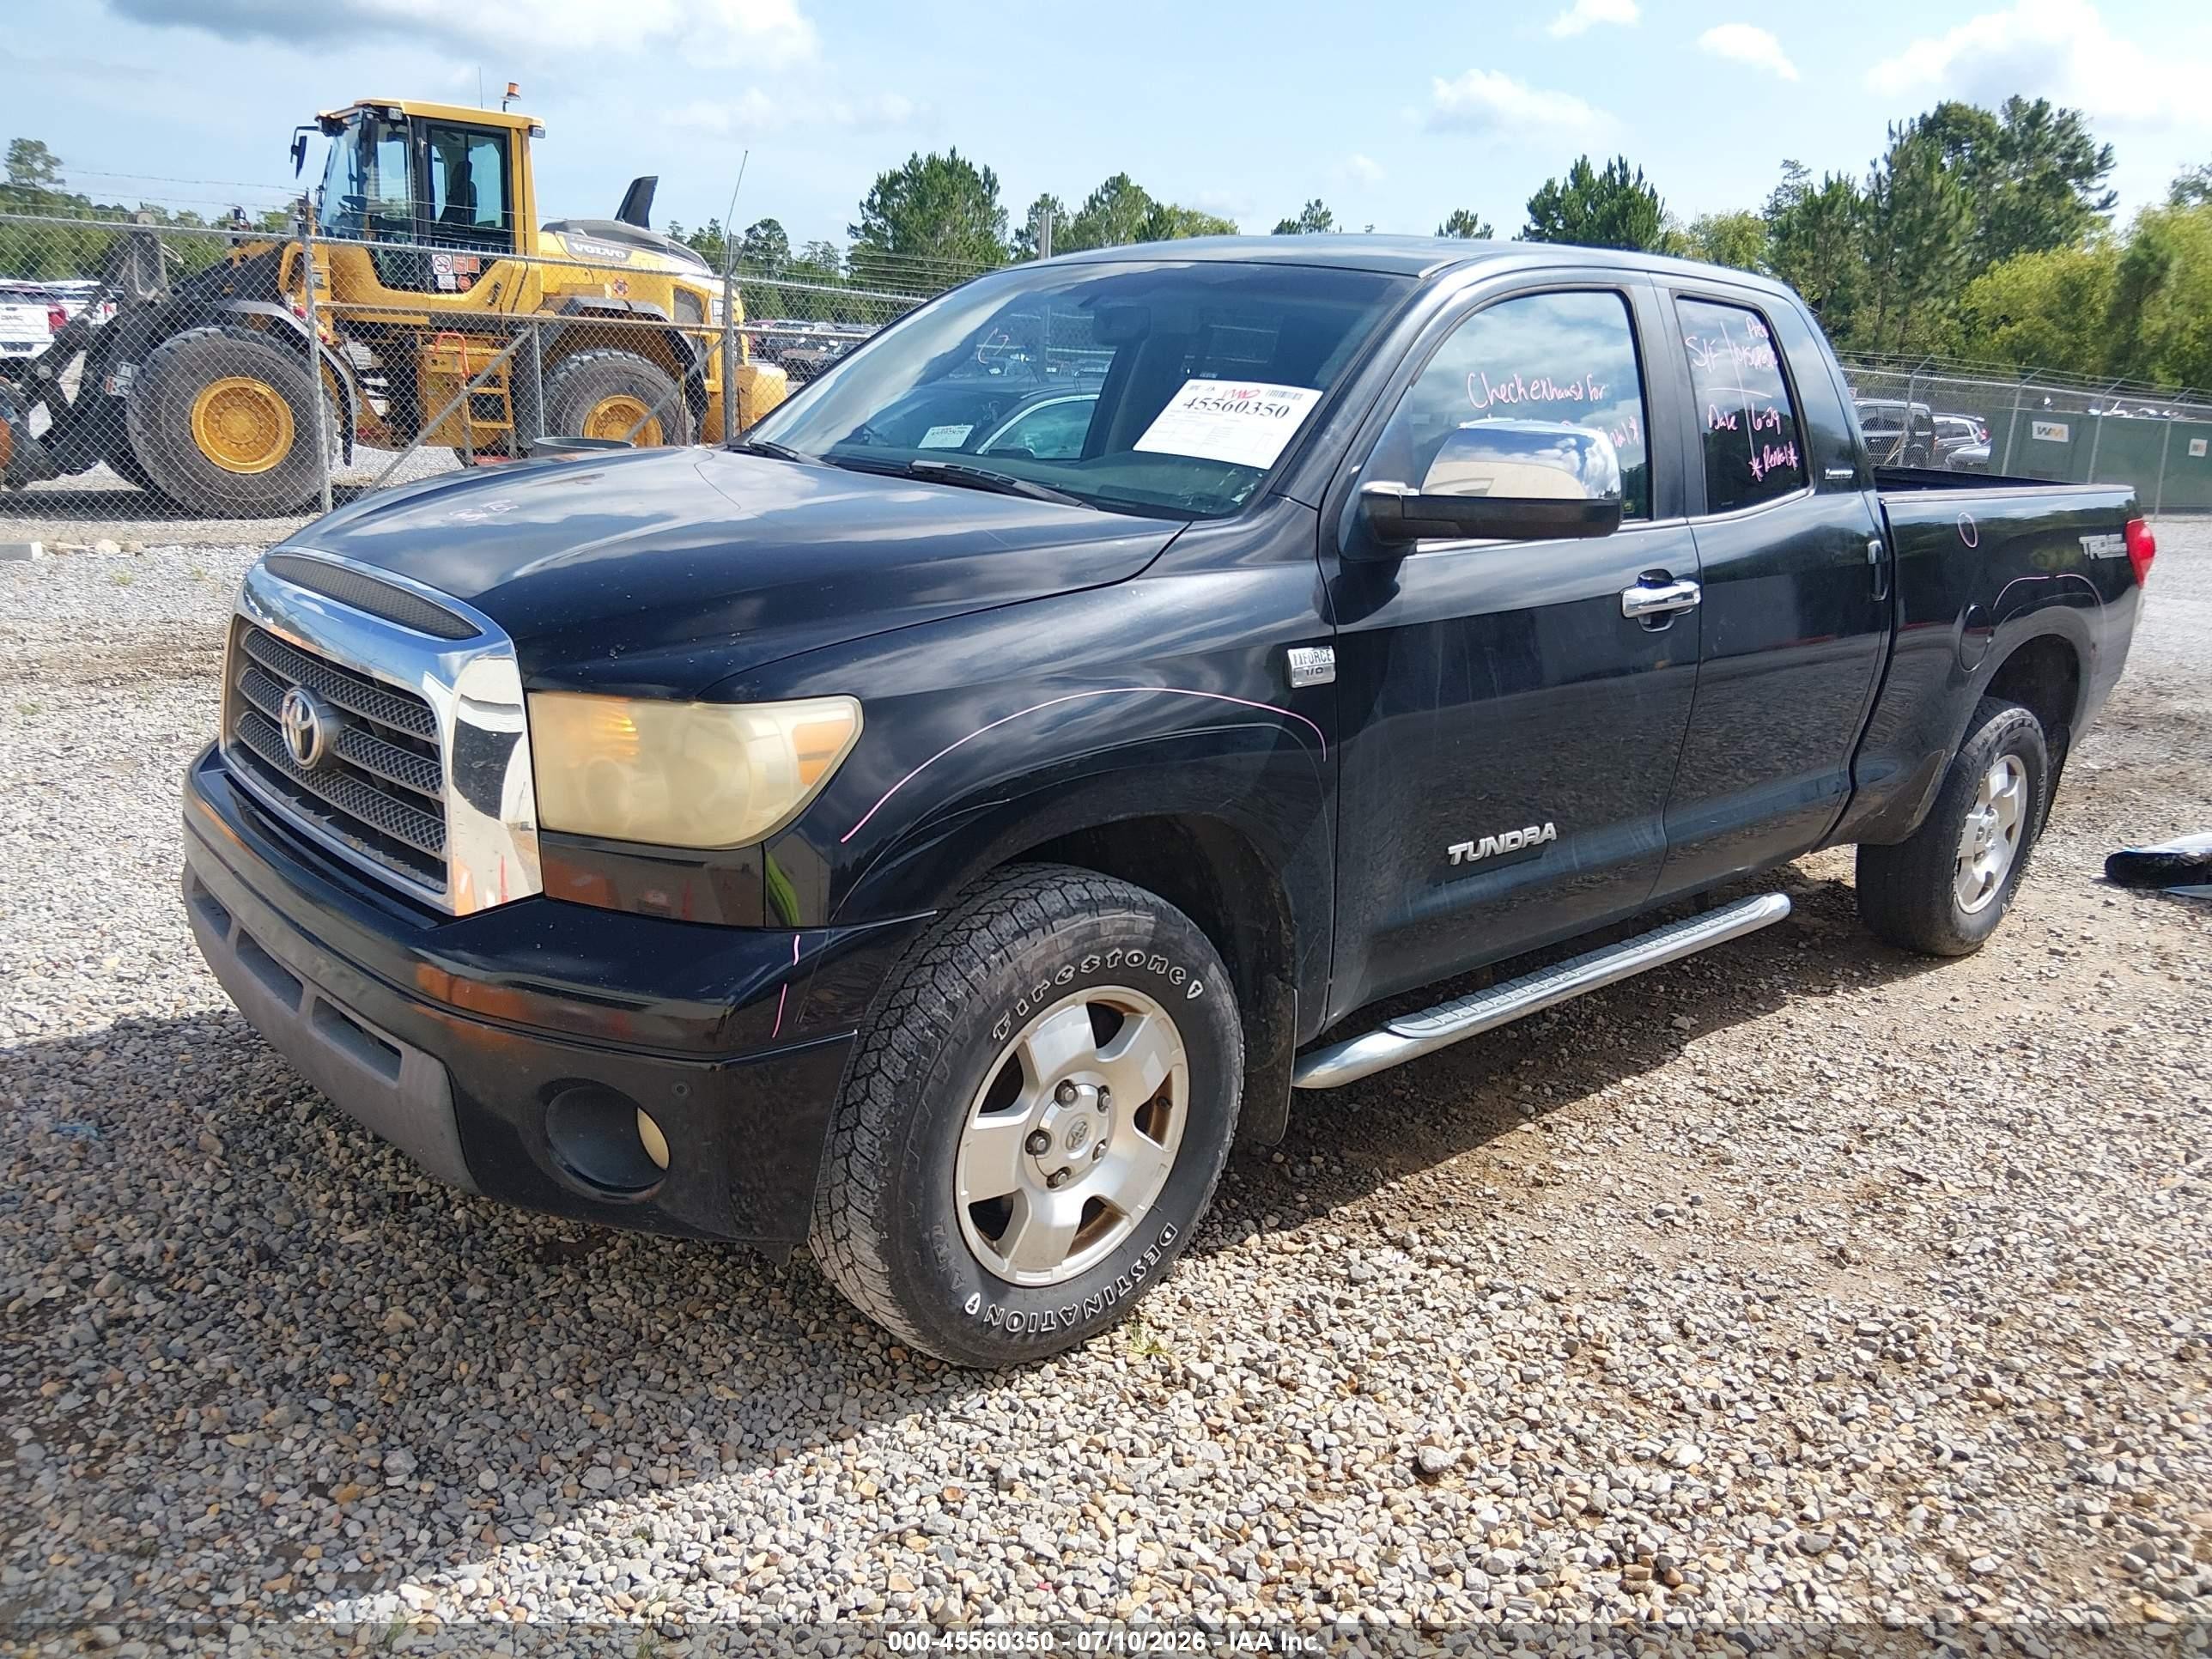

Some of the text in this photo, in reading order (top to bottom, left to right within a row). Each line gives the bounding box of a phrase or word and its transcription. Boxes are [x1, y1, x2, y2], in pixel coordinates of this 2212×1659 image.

[569, 241, 627, 258] VOLVO
[1182, 396, 1291, 420] 45560350
[1468, 371, 1528, 409] Check
[1448, 822, 1558, 866] TUNDRA
[992, 947, 1187, 1042] Firestone
[984, 1222, 1177, 1334] DESTINATION
